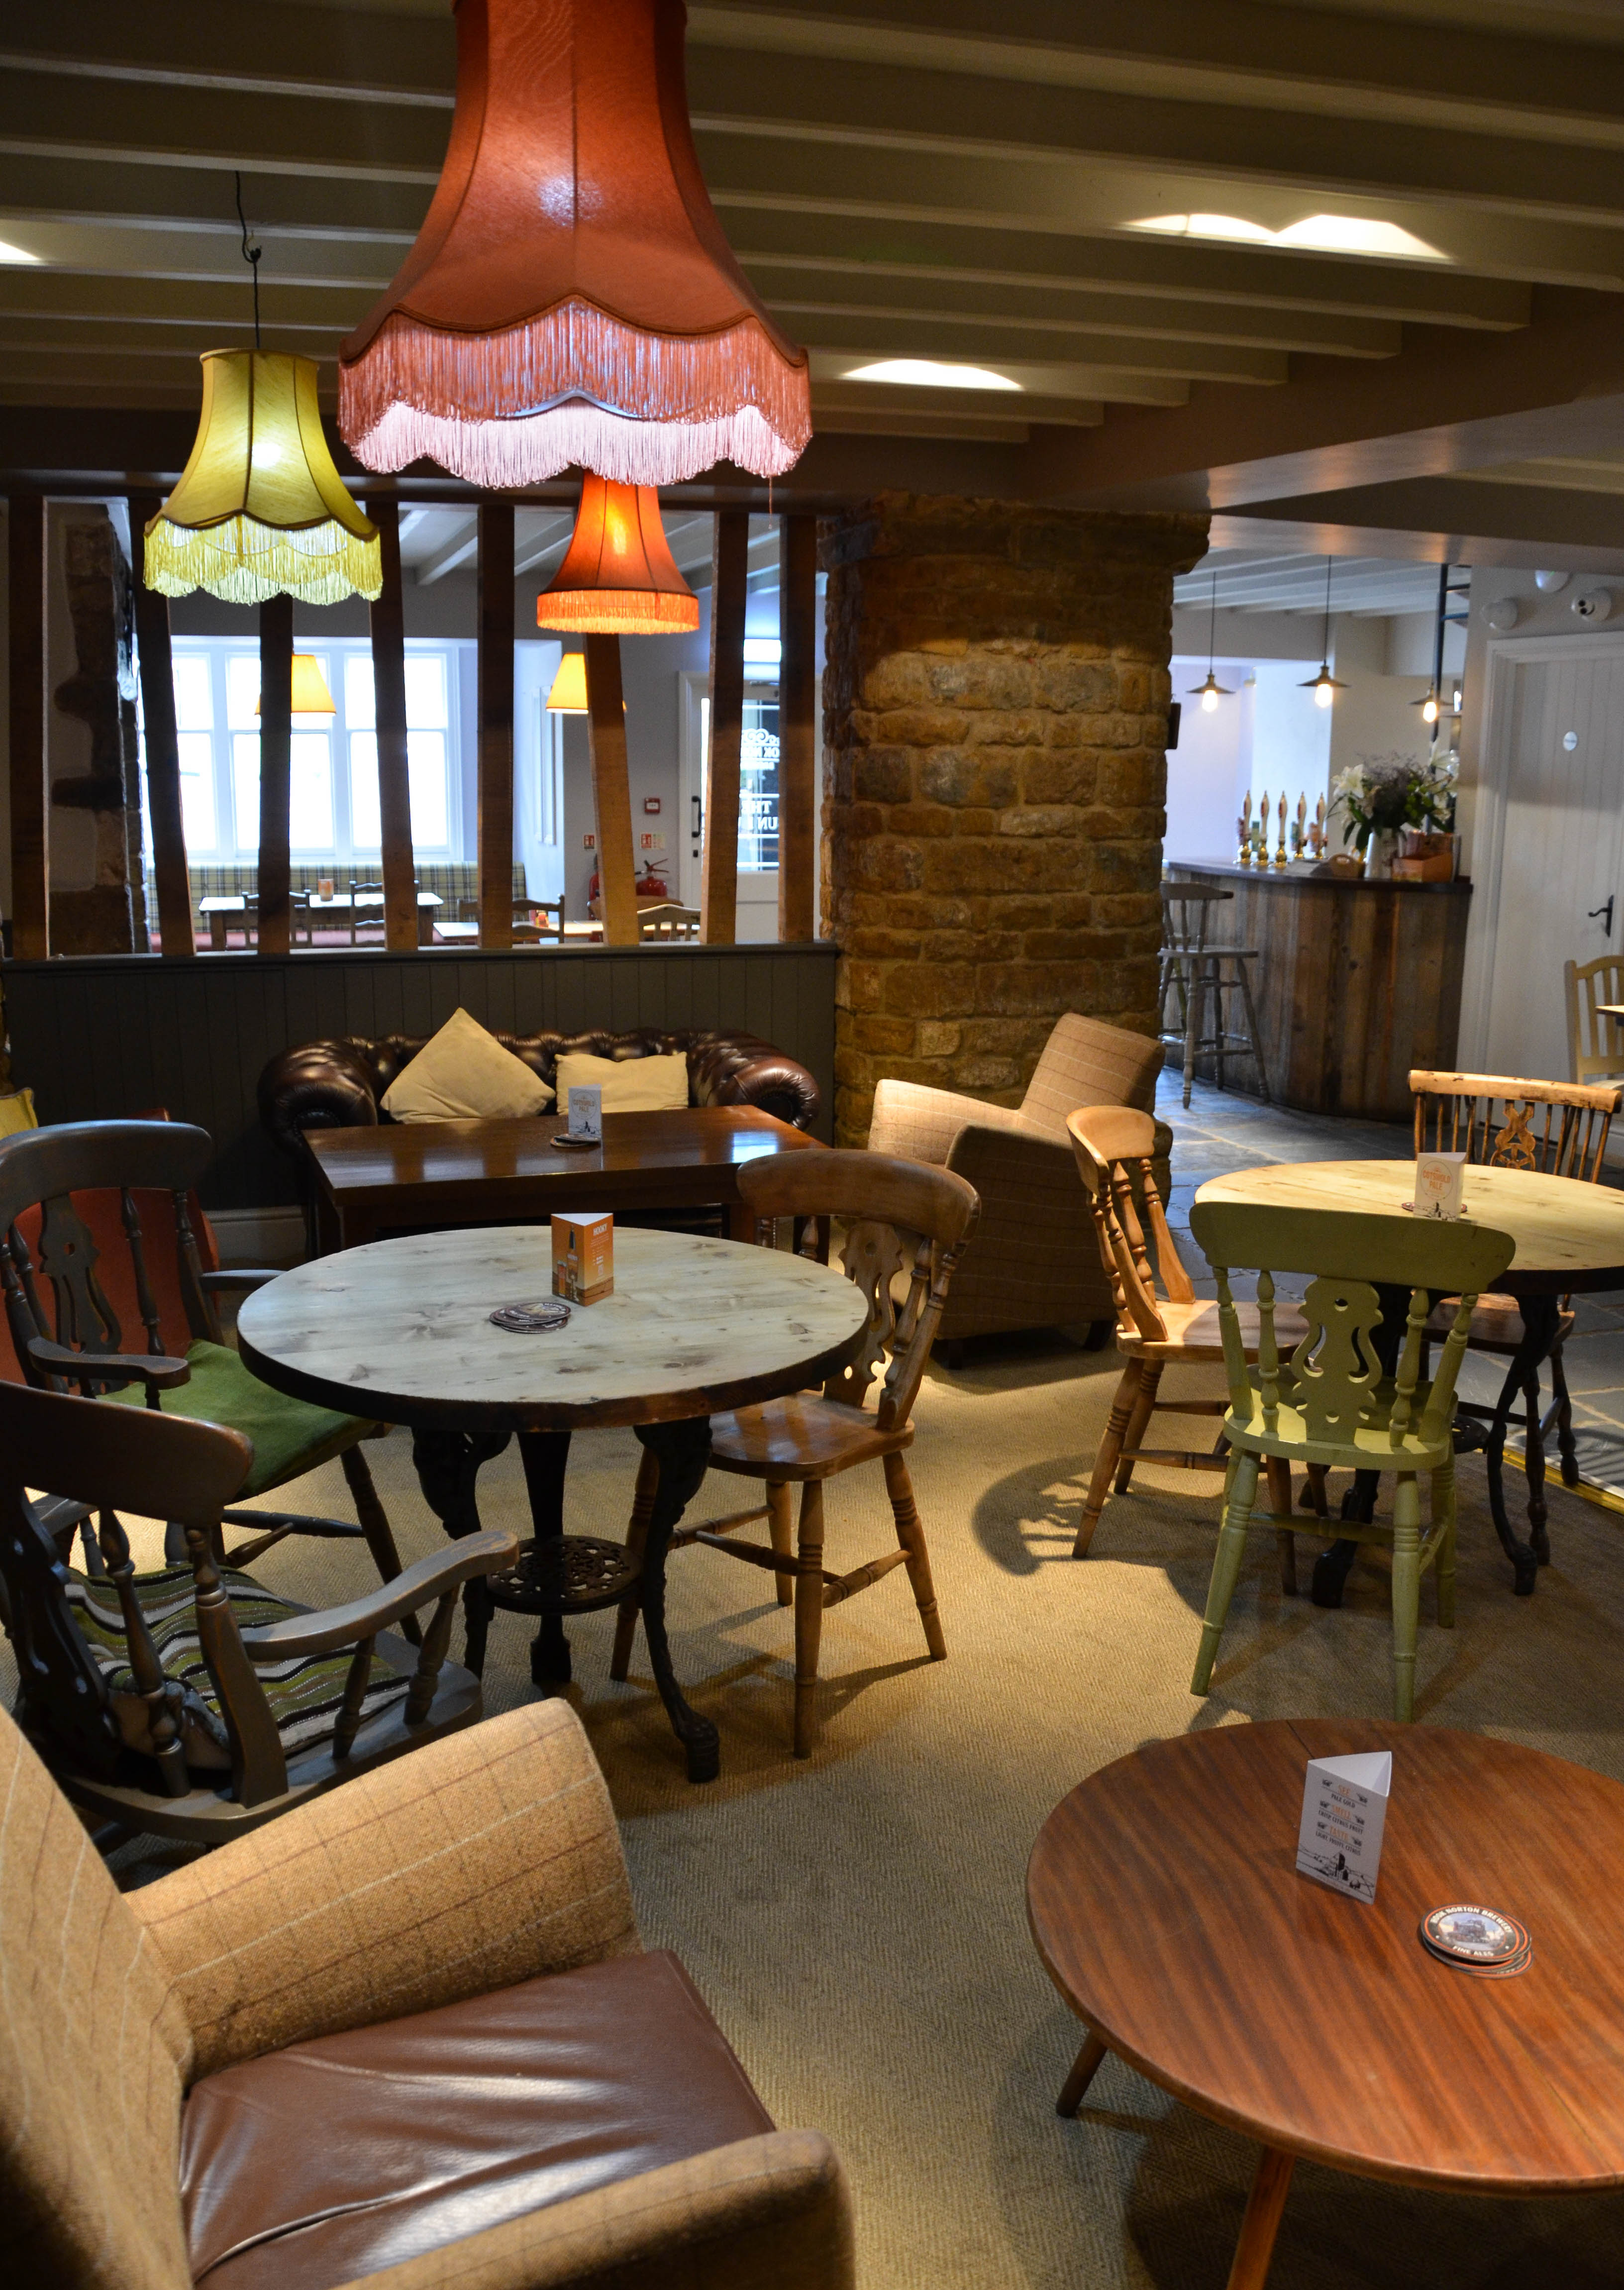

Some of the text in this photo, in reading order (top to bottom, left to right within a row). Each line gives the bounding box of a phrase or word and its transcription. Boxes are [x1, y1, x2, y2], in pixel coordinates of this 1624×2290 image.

[1423, 1170, 1451, 1183] COTSWOLD
[1429, 1181, 1443, 1191] PALE
[1338, 1784, 1351, 1796] SEE
[1331, 1793, 1355, 1808] PALE GOLD
[1332, 1805, 1351, 1820] SMELL
[1332, 1816, 1348, 1828] CITRUS
[1349, 1824, 1363, 1835] FRUIT
[1329, 1826, 1349, 1841] TASTE
[1345, 1845, 1361, 1856] CITRUS
[1445, 1906, 1480, 1914] NORTON
[1481, 1909, 1514, 1933] BREWERY
[1452, 1945, 1472, 1954] FINE
